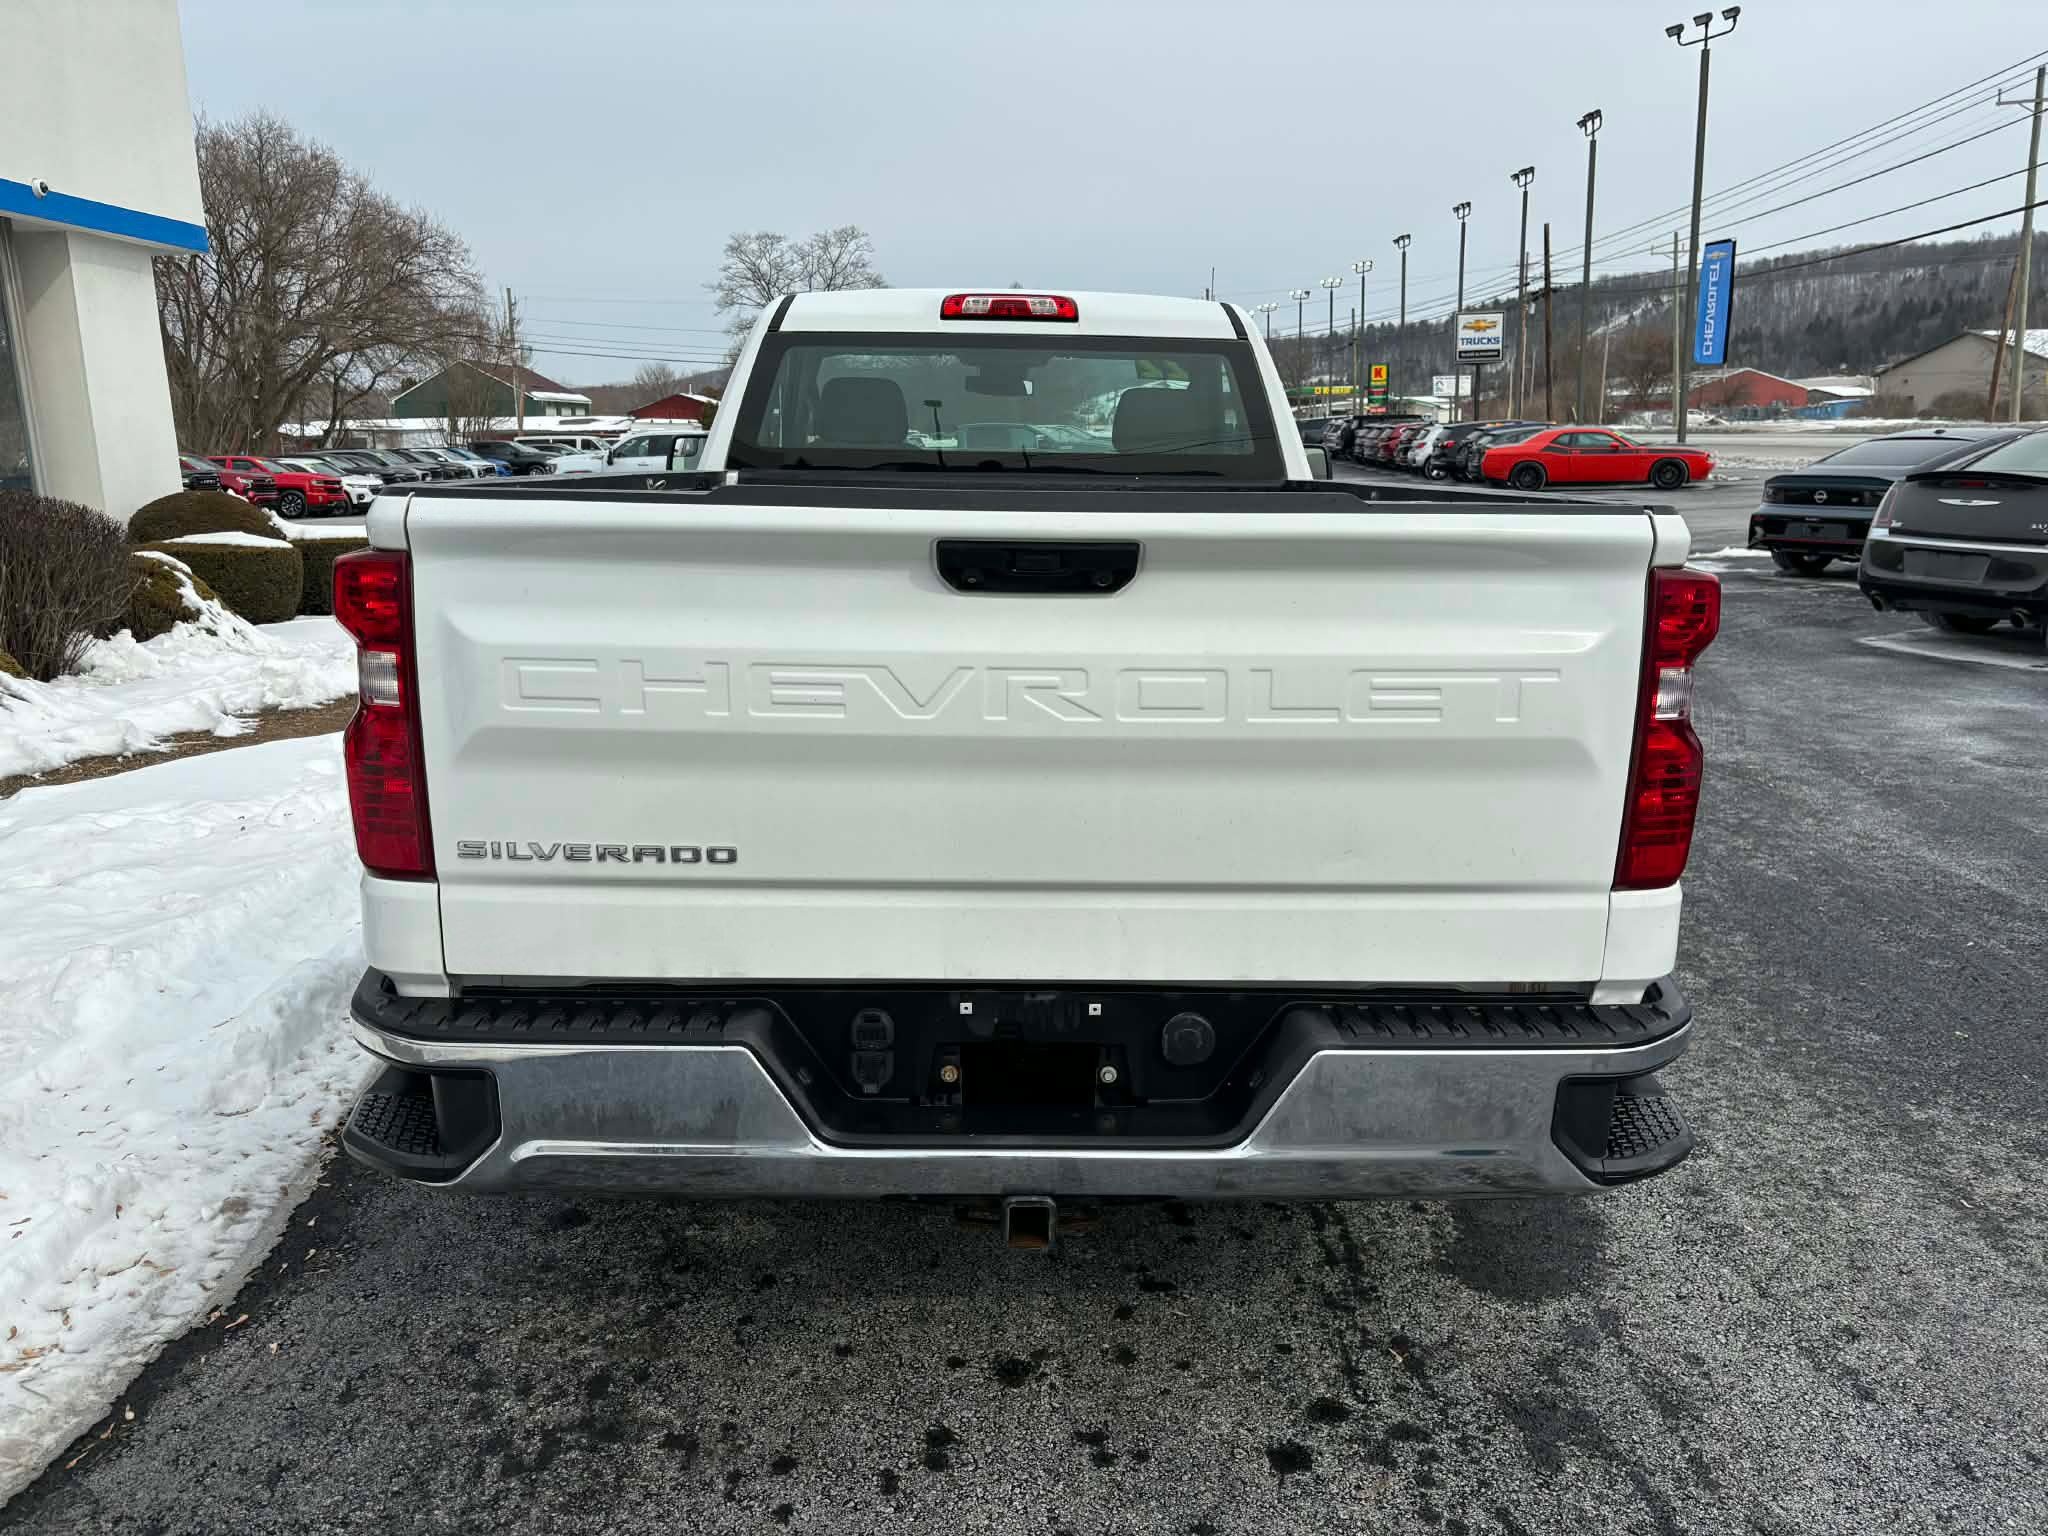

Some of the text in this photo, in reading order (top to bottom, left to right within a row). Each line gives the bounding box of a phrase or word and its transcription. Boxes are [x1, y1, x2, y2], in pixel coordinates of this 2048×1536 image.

[1460, 336, 1500, 345] TRUCKS
[1373, 367, 1383, 379] K
[500, 656, 1562, 723] CHEVROLET
[456, 840, 738, 864] SILVERADO
